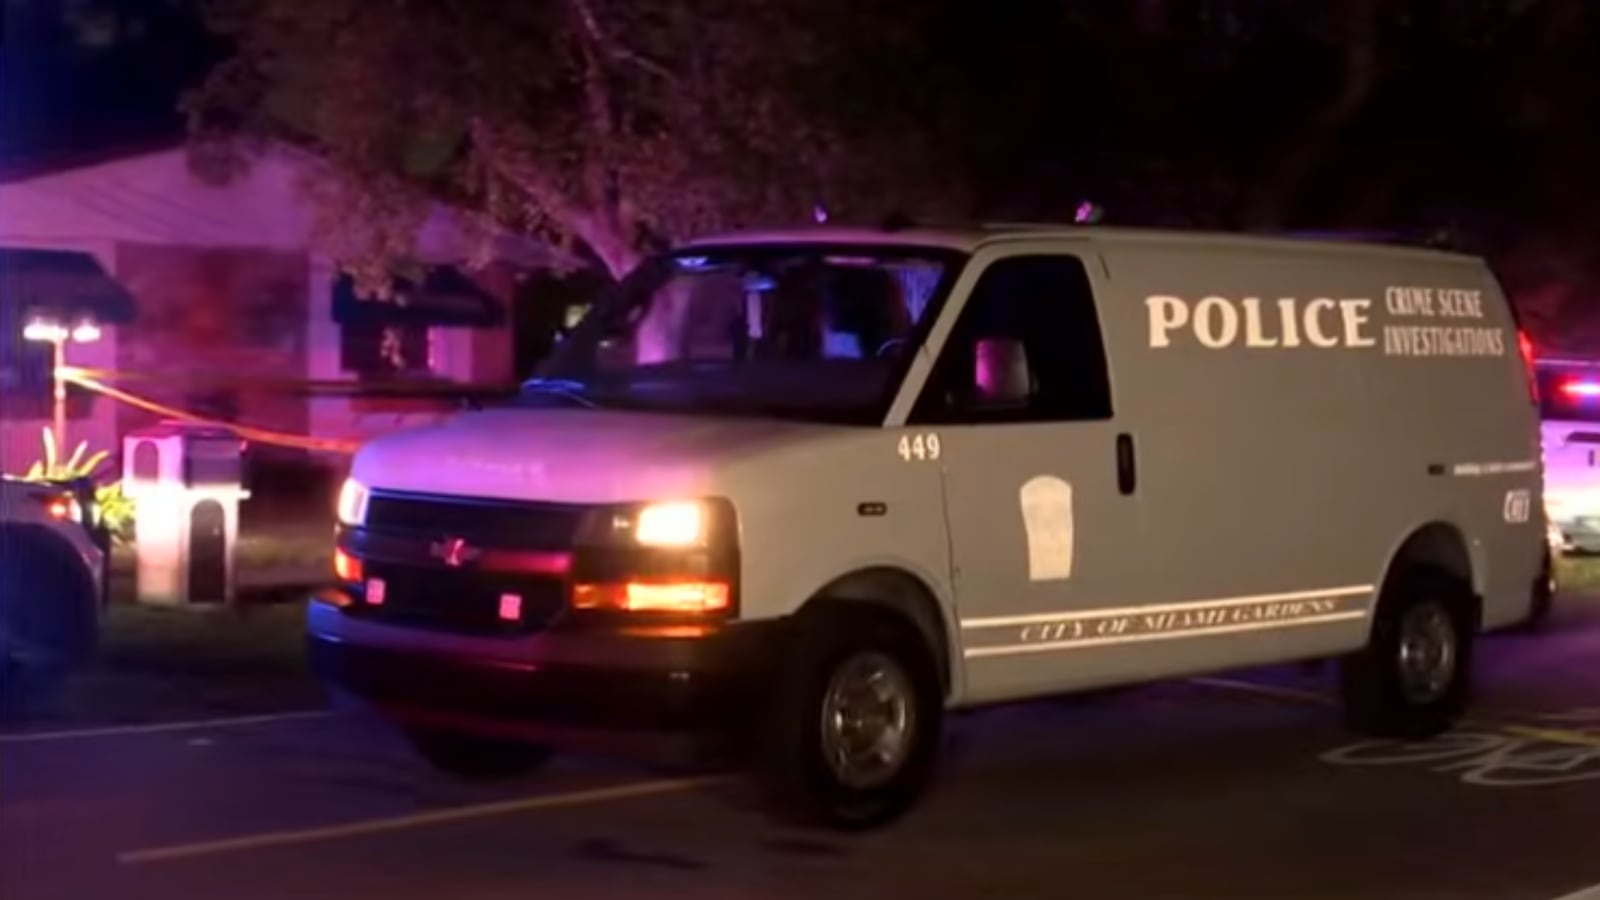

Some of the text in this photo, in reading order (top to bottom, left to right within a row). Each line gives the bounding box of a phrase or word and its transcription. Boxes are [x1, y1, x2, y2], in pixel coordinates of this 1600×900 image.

[1385, 287, 1483, 318] CRIME SCENE
[1146, 296, 1375, 348] POLICE
[1384, 326, 1504, 356] INVESTIGATIONS
[898, 433, 940, 461] 449
[1020, 599, 1337, 642] CITY OF MIAMI GARDENS
